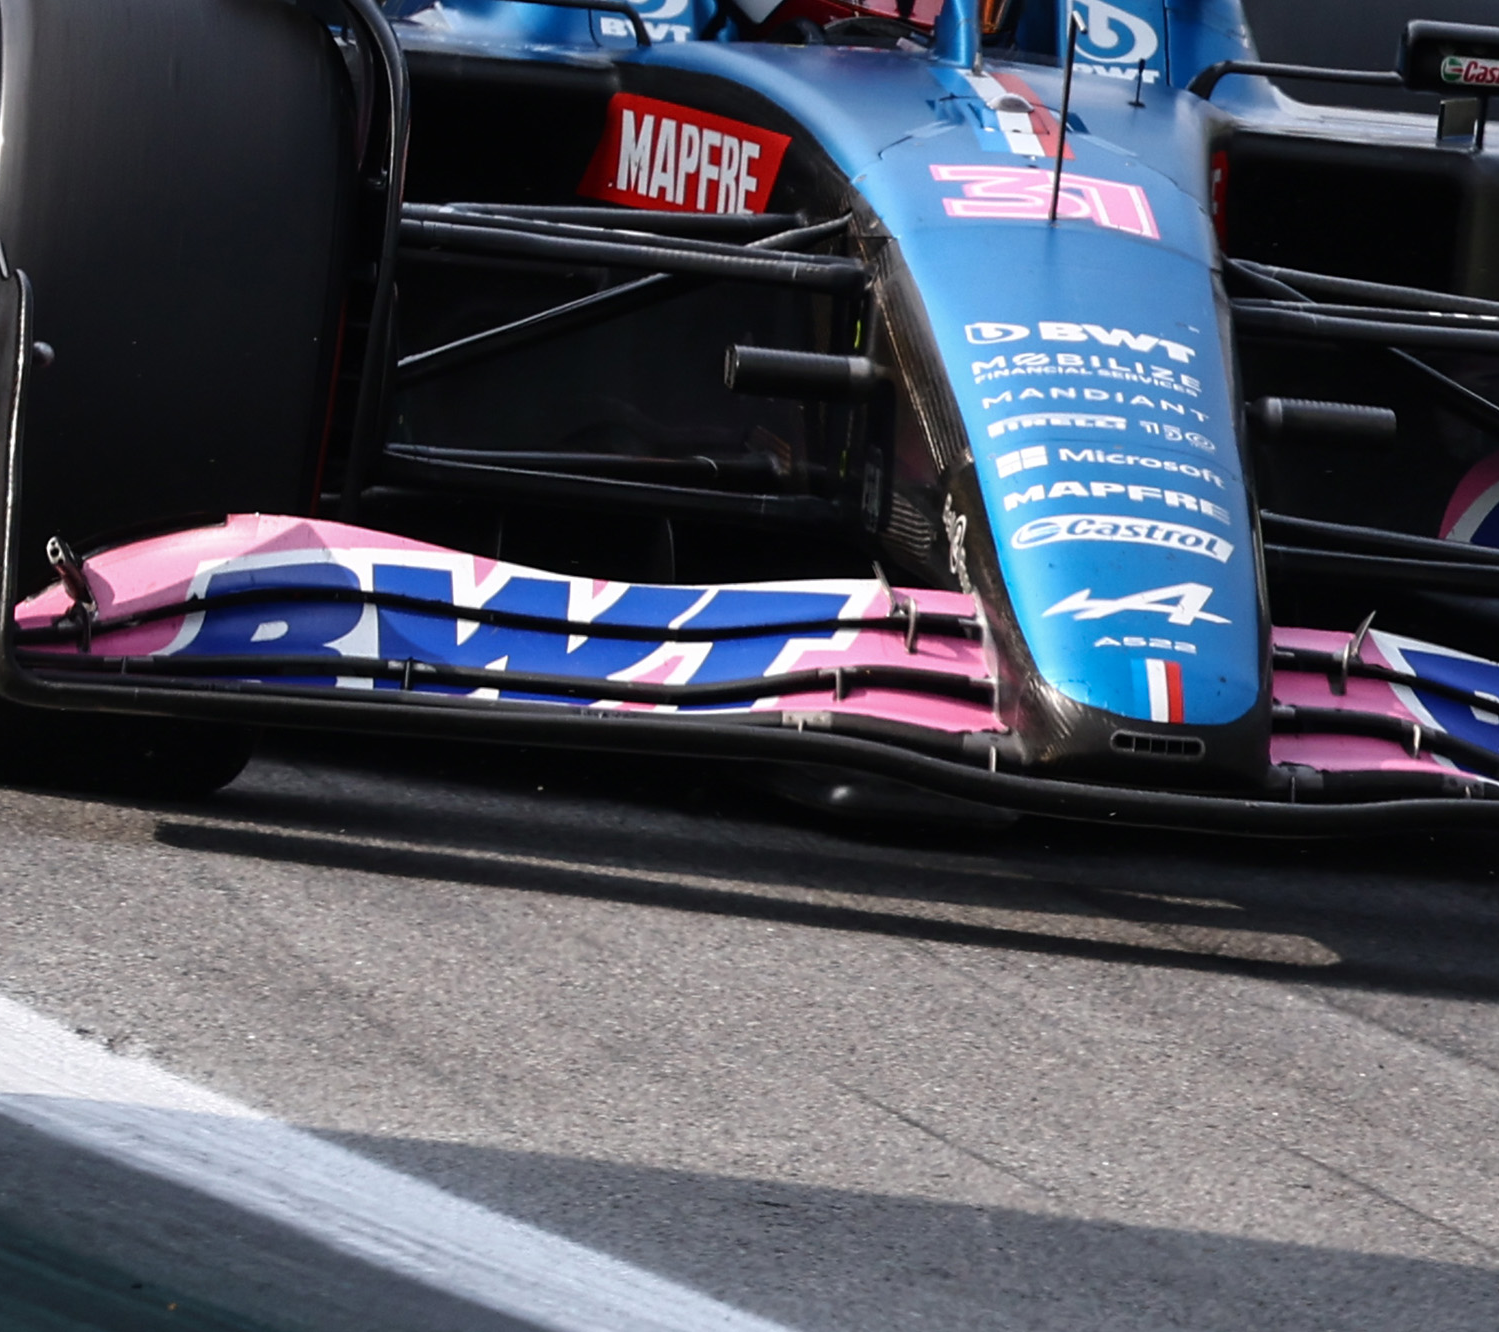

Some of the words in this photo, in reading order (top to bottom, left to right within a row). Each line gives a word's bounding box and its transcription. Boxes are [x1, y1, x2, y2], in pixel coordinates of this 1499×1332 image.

[601, 16, 690, 42] BWT
[616, 108, 761, 216] MAPFRE
[928, 164, 1161, 241] 31
[1038, 321, 1196, 364] BWT
[973, 365, 1094, 385] FINANCIAL
[1097, 369, 1199, 398] SERVICES
[981, 386, 1210, 423] MANDIANT
[1058, 447, 1226, 490] Microsoft
[1003, 480, 1232, 526] MAPFRE
[1066, 518, 1218, 557] Castrol
[183, 560, 852, 711] BWT
[1094, 635, 1197, 655] A522
